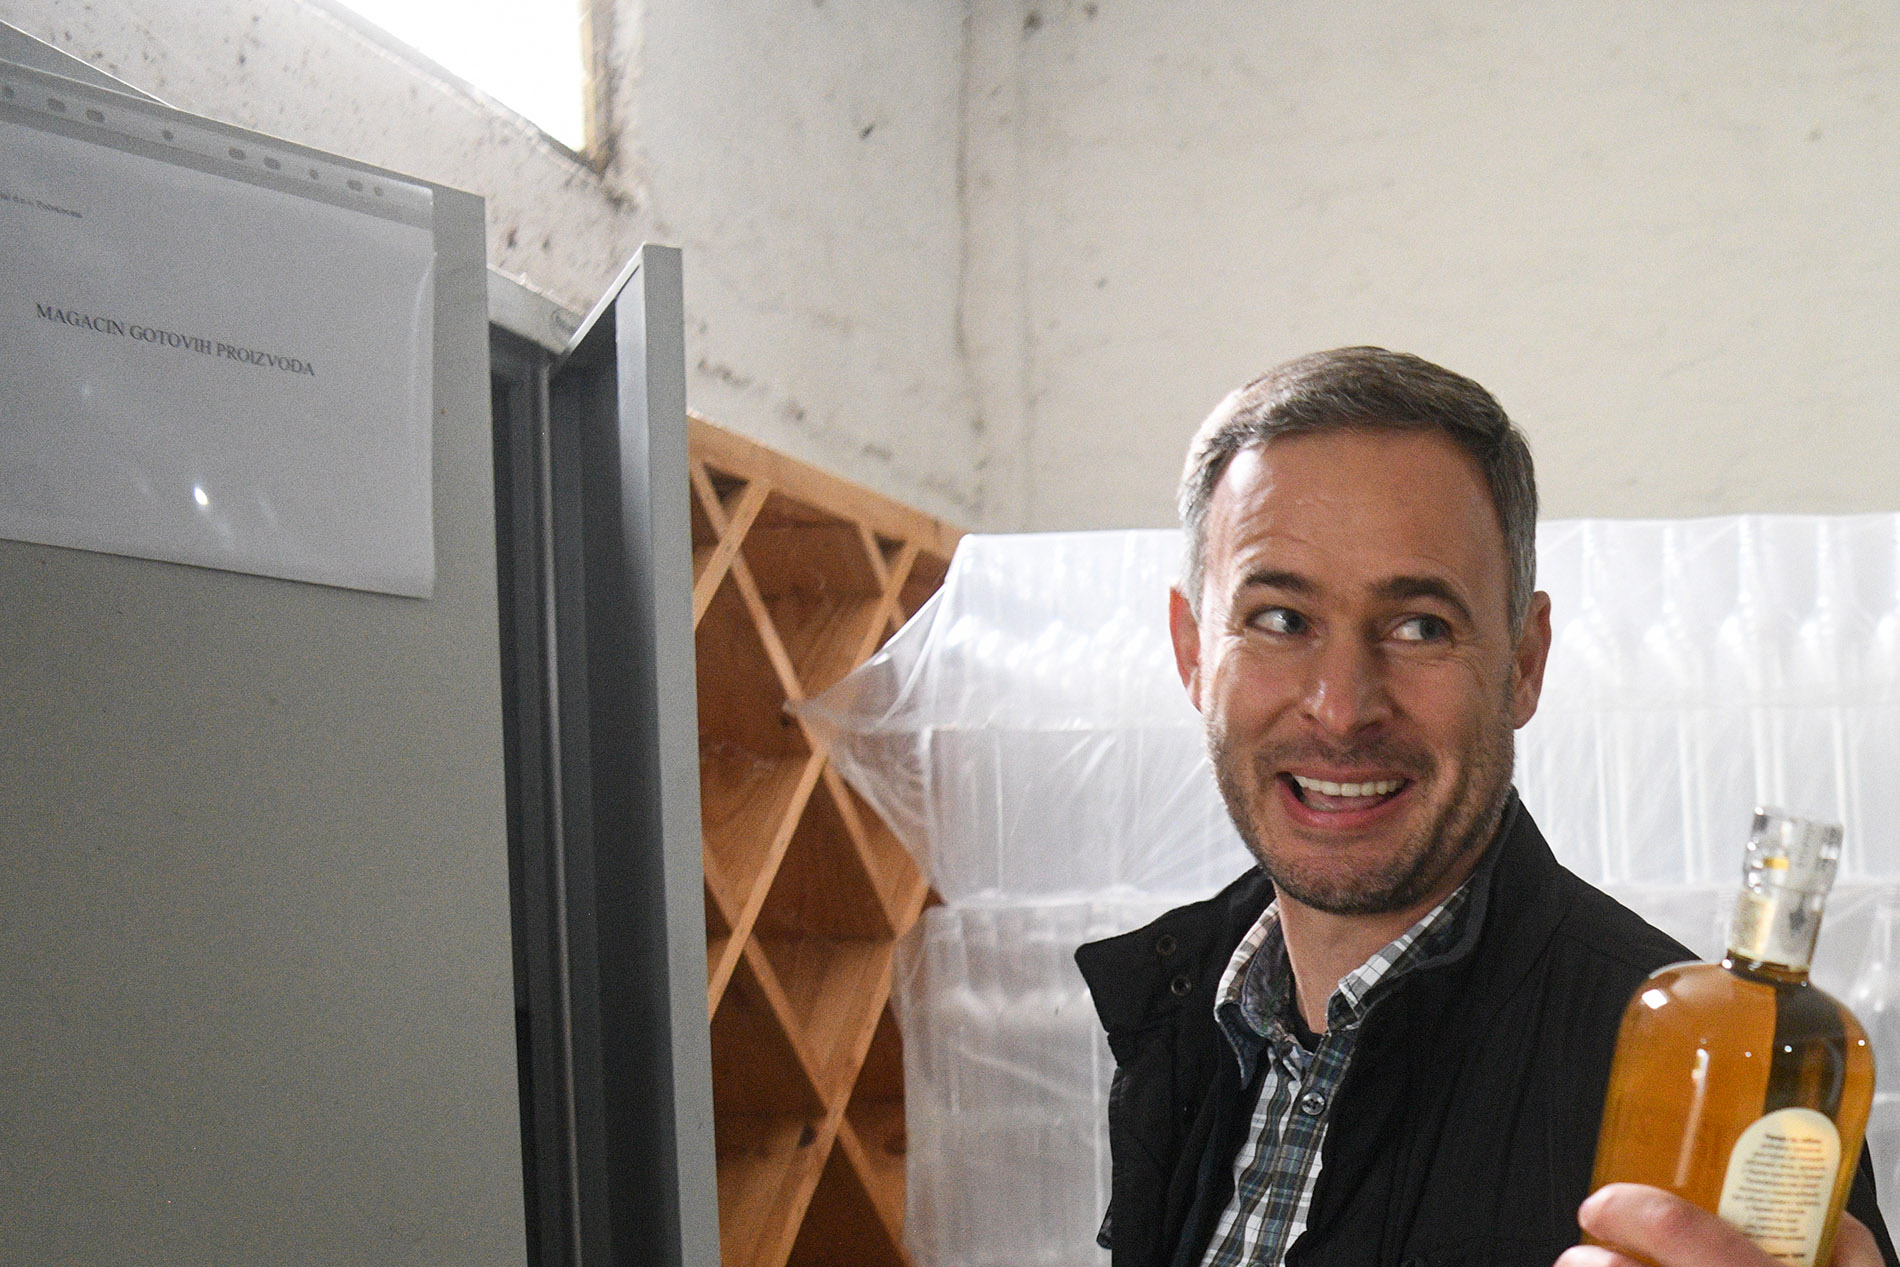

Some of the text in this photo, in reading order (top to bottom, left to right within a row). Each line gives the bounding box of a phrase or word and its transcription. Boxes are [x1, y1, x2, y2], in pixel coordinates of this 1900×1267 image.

[36, 303, 315, 376] MAGACIN GOTOVIH PROIZVODA
